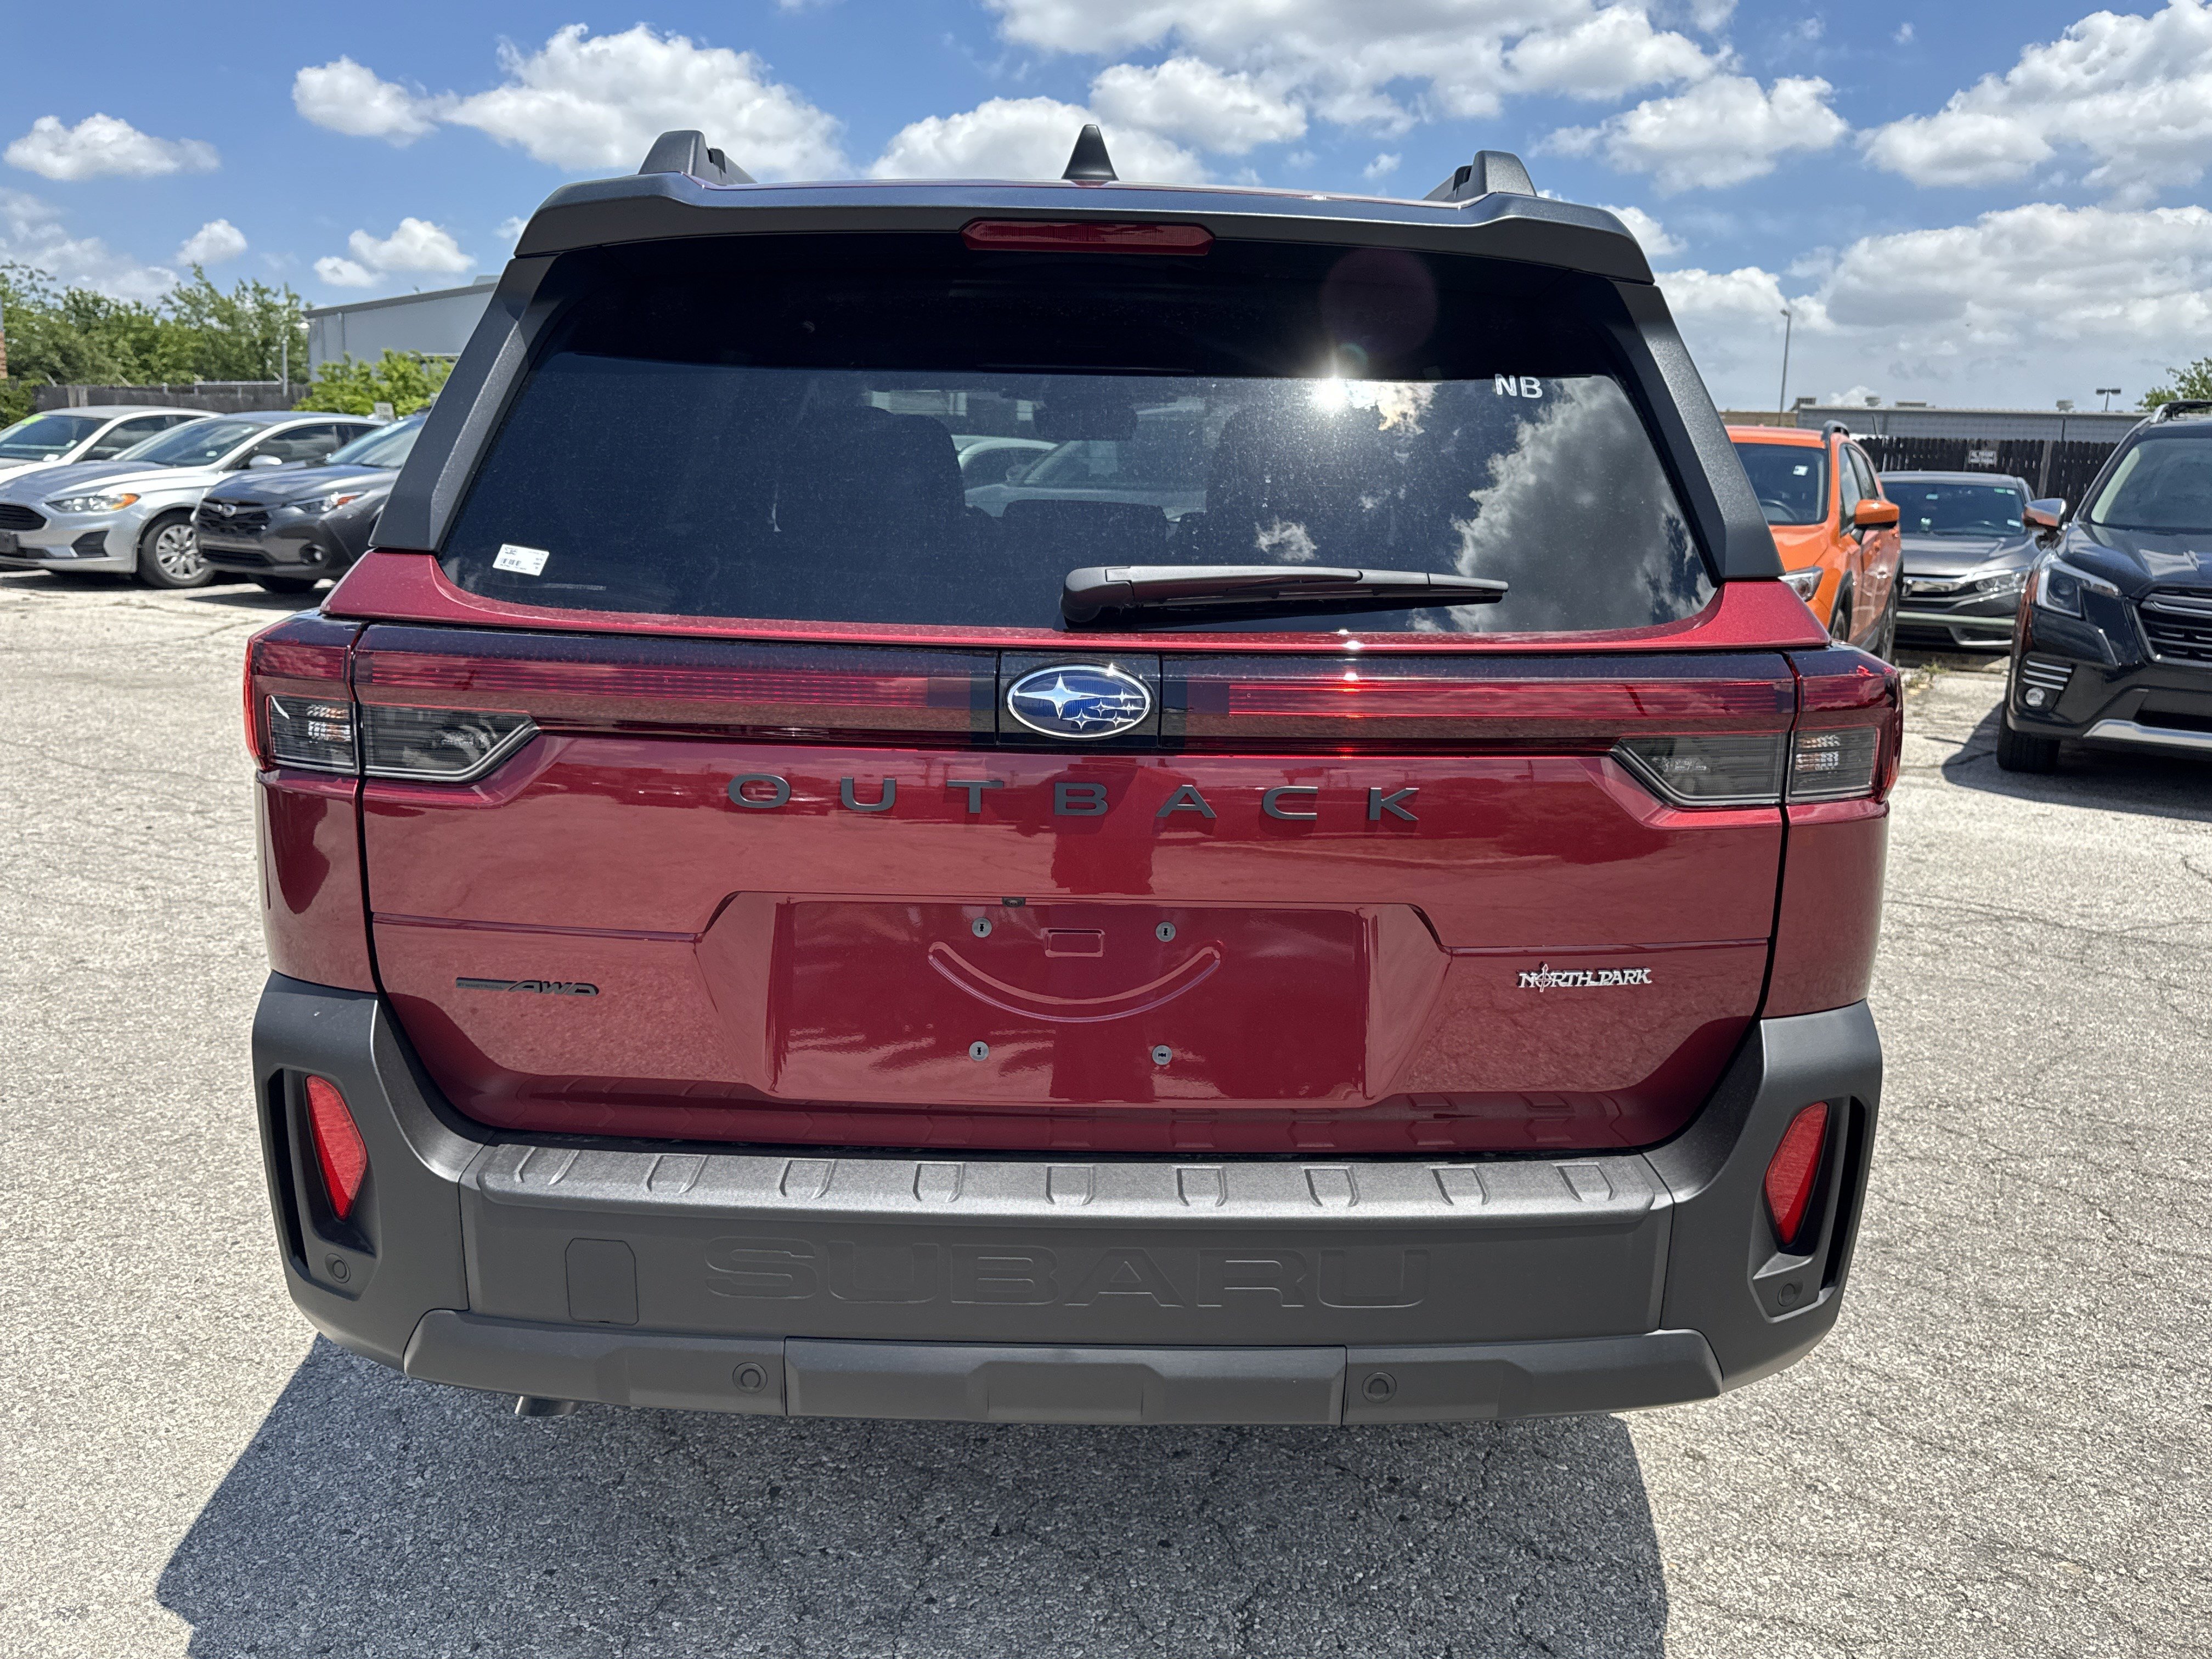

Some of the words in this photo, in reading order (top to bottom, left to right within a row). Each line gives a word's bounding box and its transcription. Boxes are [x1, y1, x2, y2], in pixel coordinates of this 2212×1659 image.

[1494, 373, 1543, 398] NB
[728, 774, 1419, 821] OUTBACK
[508, 980, 600, 996] AWD
[1518, 963, 1594, 992] NORTH
[1597, 967, 1652, 986] PARK
[704, 1235, 1429, 1308] SUBARU
